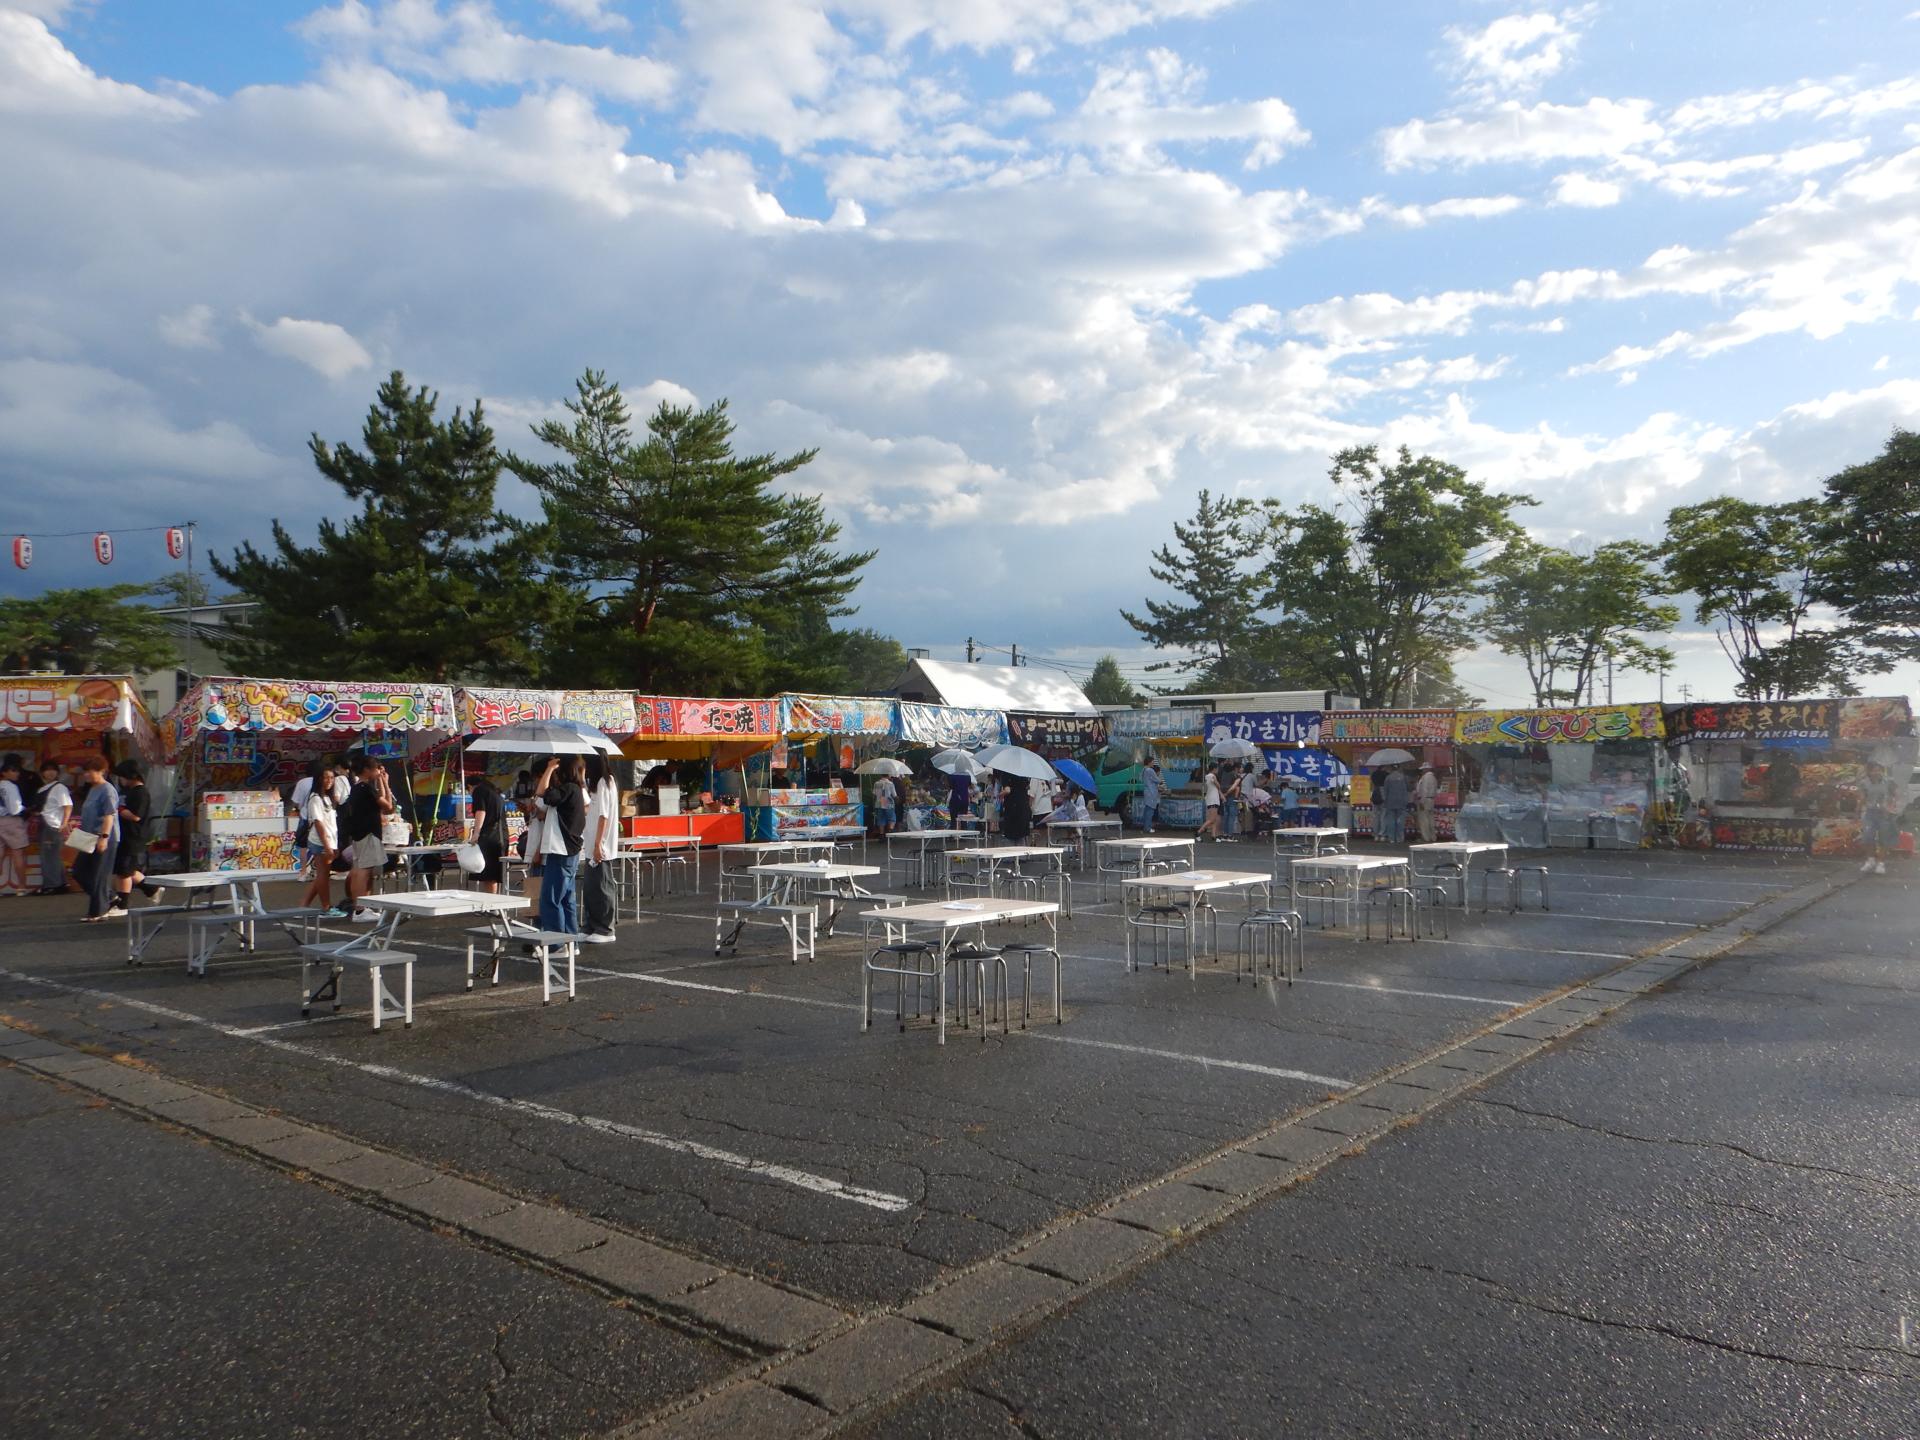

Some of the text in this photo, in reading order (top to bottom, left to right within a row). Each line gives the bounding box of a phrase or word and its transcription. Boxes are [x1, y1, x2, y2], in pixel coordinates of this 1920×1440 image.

[303, 692, 418, 726] ジュース
[656, 701, 673, 733] 特製
[708, 704, 755, 733] たこ焼
[759, 703, 771, 733] 特製
[1027, 718, 1095, 734] チーズハットグ
[1235, 714, 1307, 742] かき氷
[1497, 711, 1632, 741] くじびき
[1695, 730, 1829, 739] KIWAMI YAKISOBA
